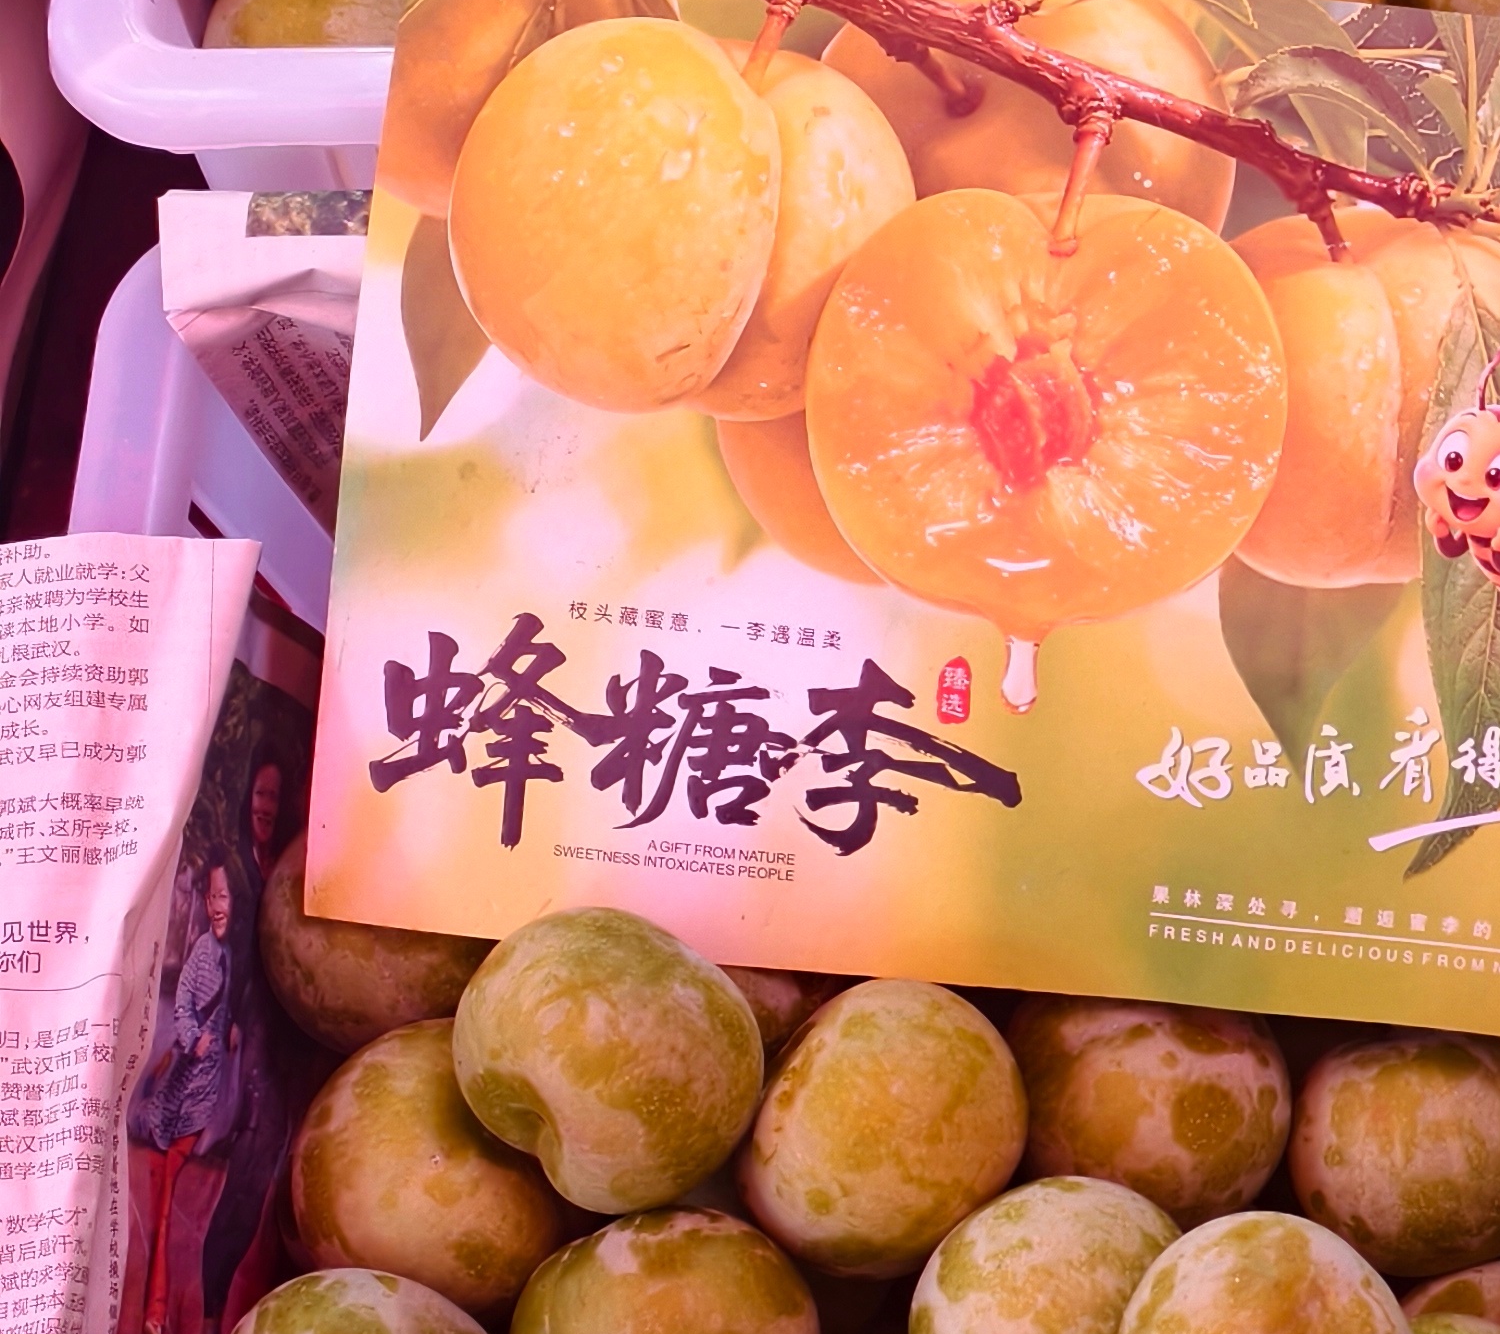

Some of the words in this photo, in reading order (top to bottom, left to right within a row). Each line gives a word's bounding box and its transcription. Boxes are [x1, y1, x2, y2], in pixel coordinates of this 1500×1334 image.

[0, 587, 149, 616] 亲被聘为学校生
[368, 612, 1023, 855] 蜂糖李
[553, 844, 641, 866] SWEETNESS
[643, 854, 735, 877] INTOXICATES
[737, 865, 795, 882] PEOPLE
[647, 839, 658, 852] A
[659, 840, 692, 855] GIFT
[694, 844, 736, 860] FROM
[738, 849, 795, 866] NATURE
[1149, 923, 1224, 946] FRESH
[1231, 932, 1276, 952] AND
[1285, 938, 1414, 965] DELICIOUS
[1421, 951, 1485, 972] FROM
